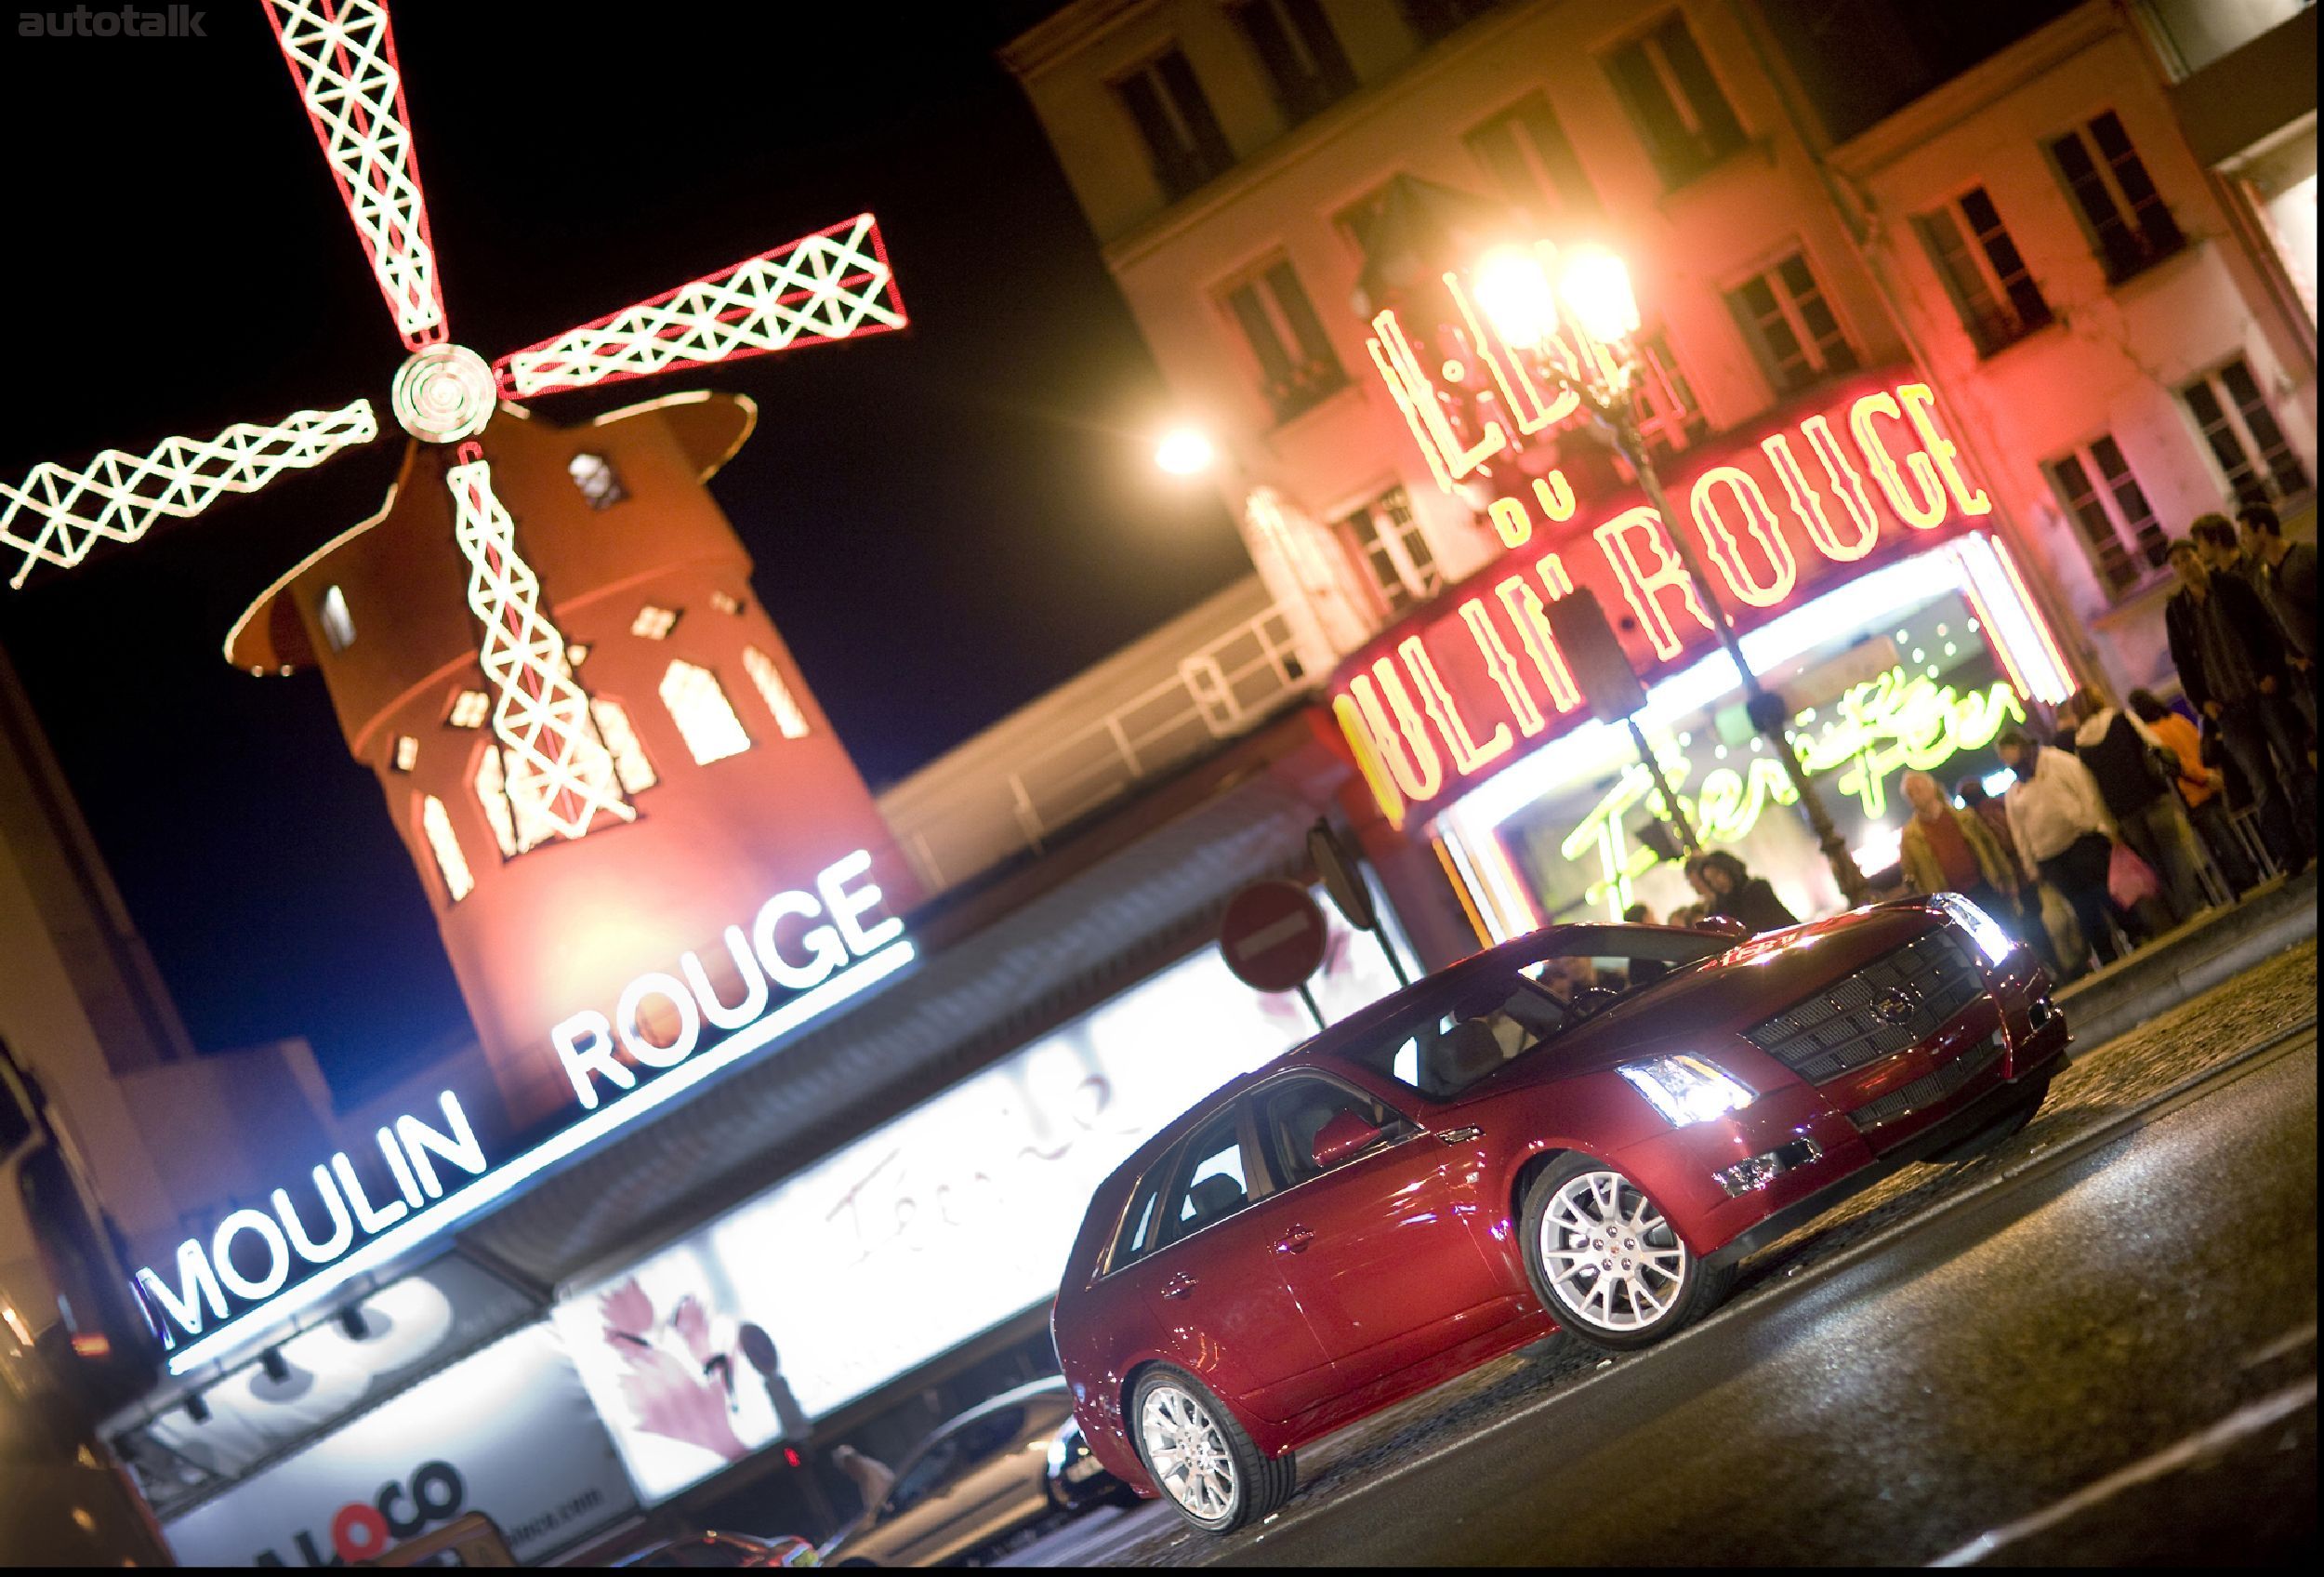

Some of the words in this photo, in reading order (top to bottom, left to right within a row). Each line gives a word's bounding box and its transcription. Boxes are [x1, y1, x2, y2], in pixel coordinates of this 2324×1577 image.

[1487, 470, 1577, 549] DU
[1593, 382, 1992, 662] ROUGE
[132, 1090, 487, 1350] MOULIN
[550, 848, 905, 1110] ROUGE
